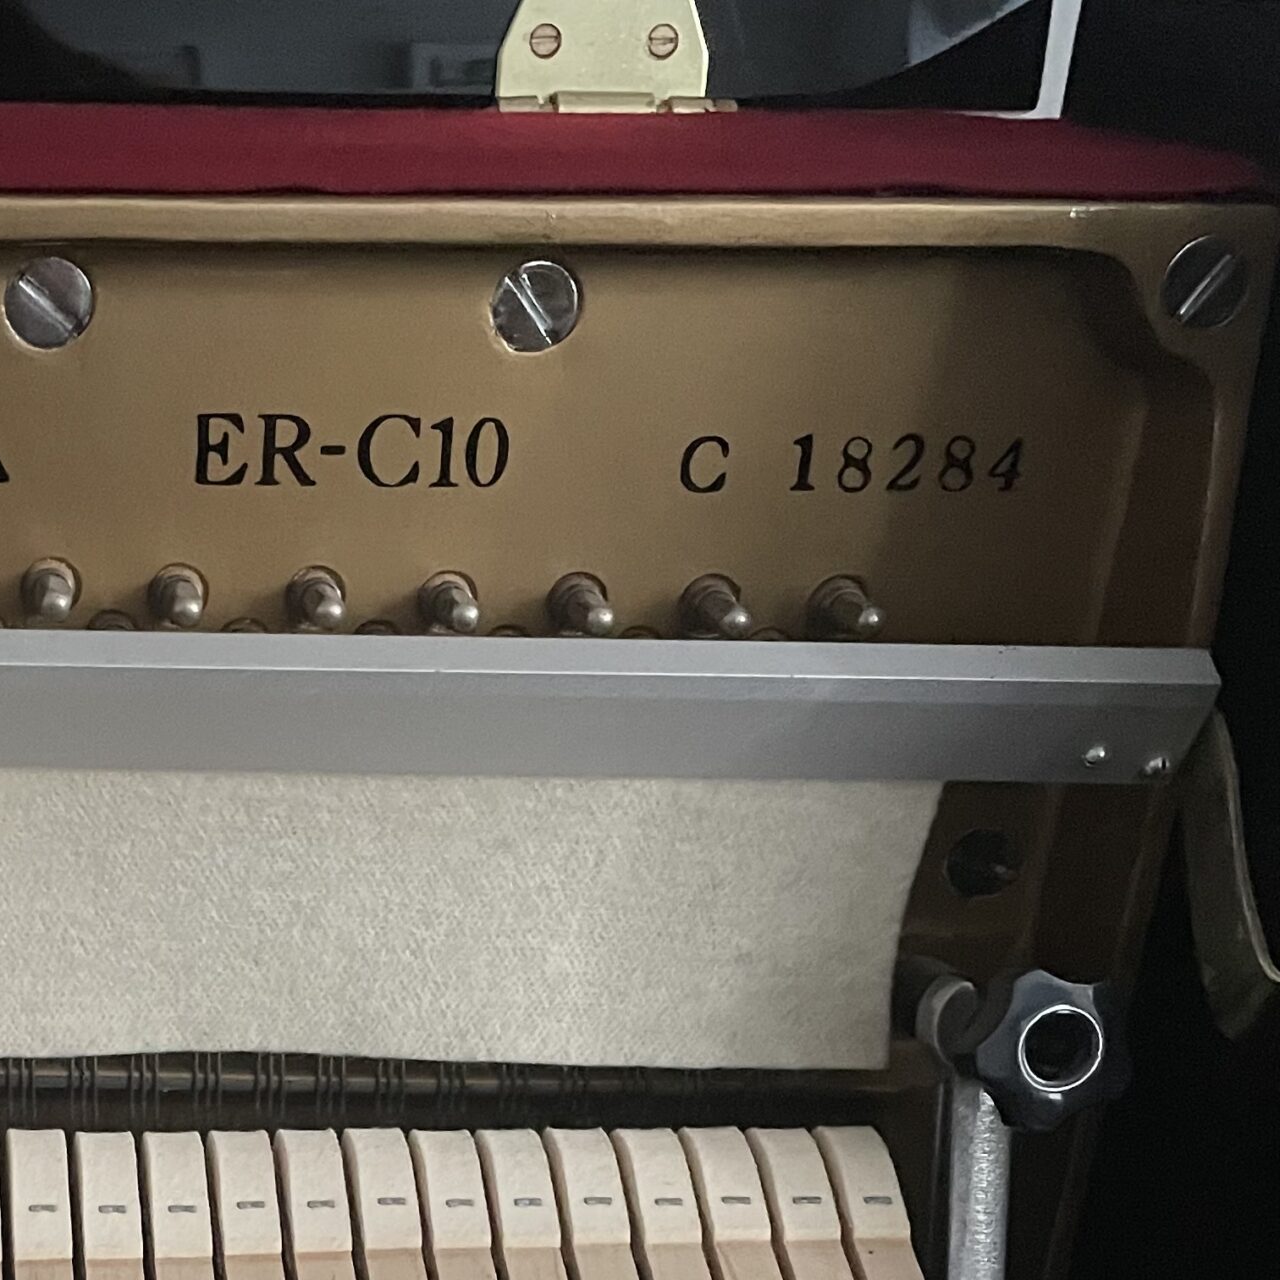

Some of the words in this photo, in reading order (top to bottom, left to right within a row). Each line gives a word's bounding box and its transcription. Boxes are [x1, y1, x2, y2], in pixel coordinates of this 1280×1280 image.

[194, 413, 510, 487] ER-C10
[680, 435, 730, 493] C
[789, 434, 1025, 492] 18284
